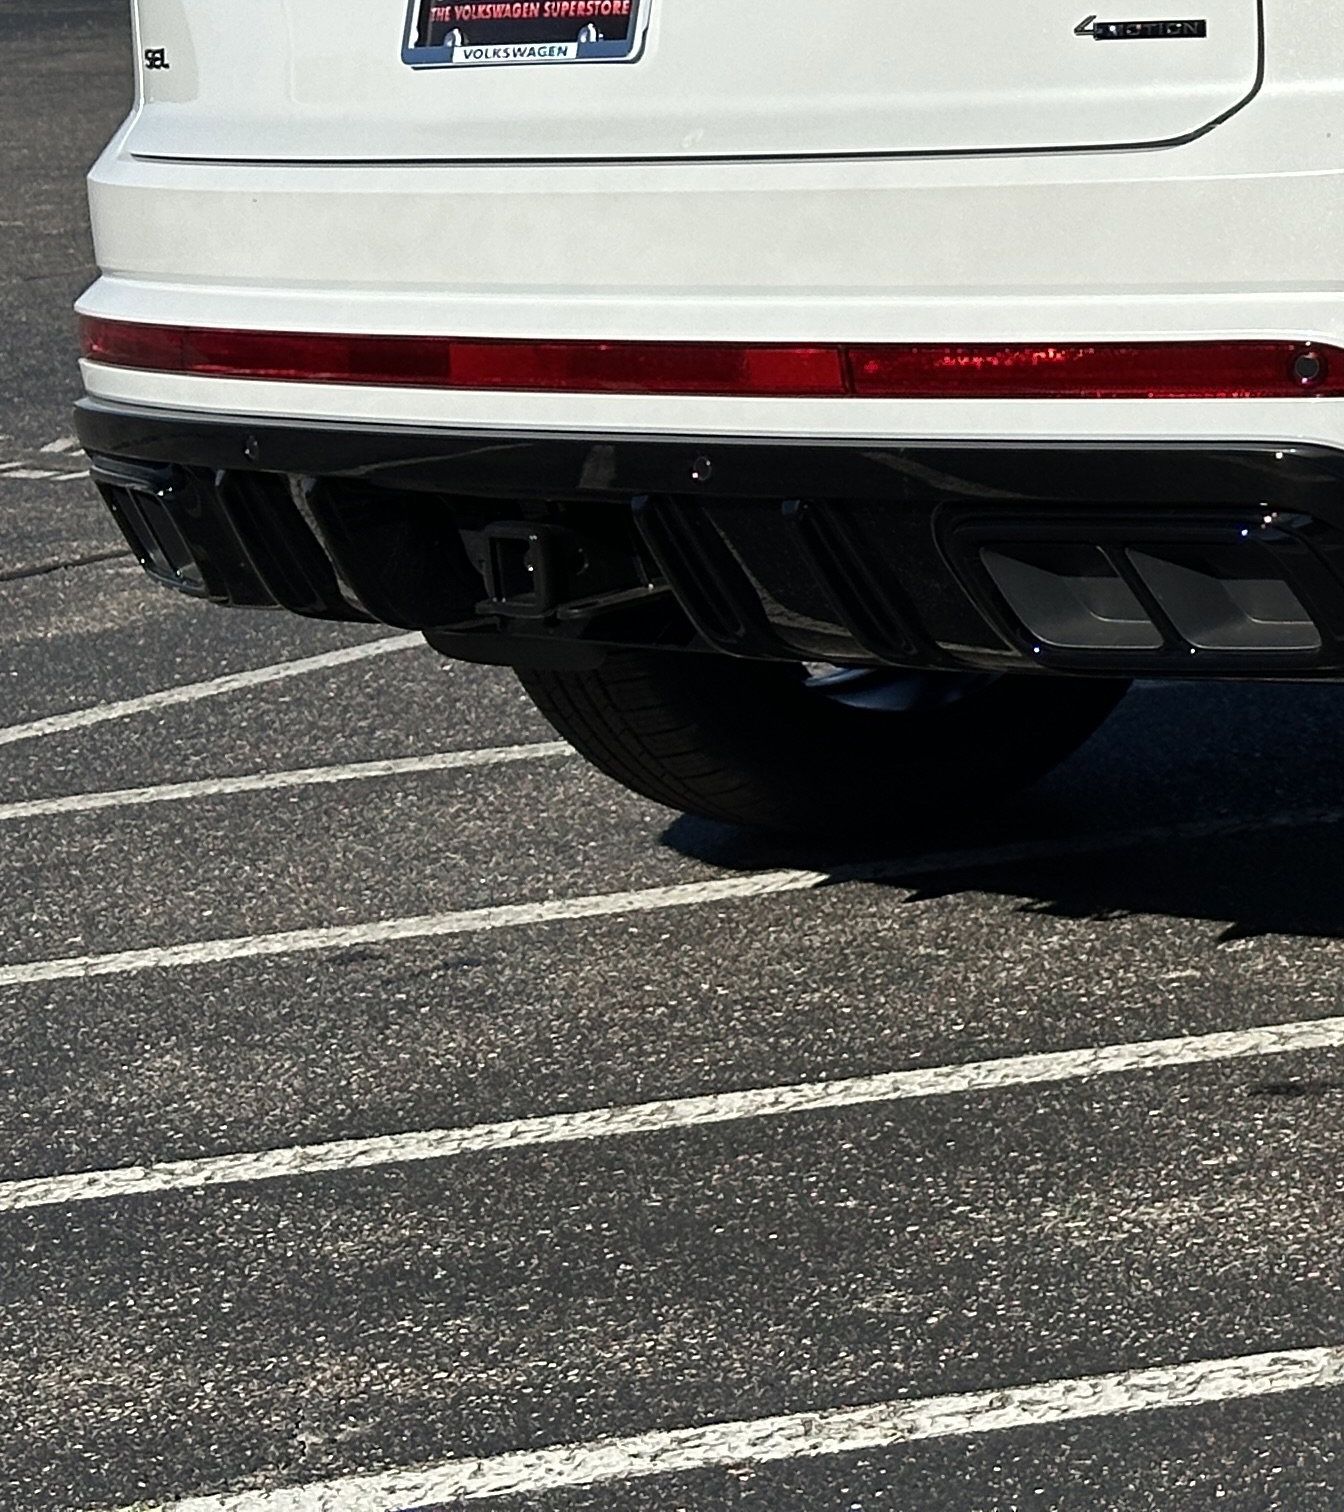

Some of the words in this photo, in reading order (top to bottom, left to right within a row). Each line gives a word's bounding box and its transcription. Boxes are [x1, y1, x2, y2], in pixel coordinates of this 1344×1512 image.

[430, 6, 451, 23] THE
[454, 1, 539, 21] VOLKSWAGEN
[543, 0, 630, 18] SUPERSTORE
[144, 47, 170, 70] SEL
[463, 44, 569, 60] VOLKSWAGEN
